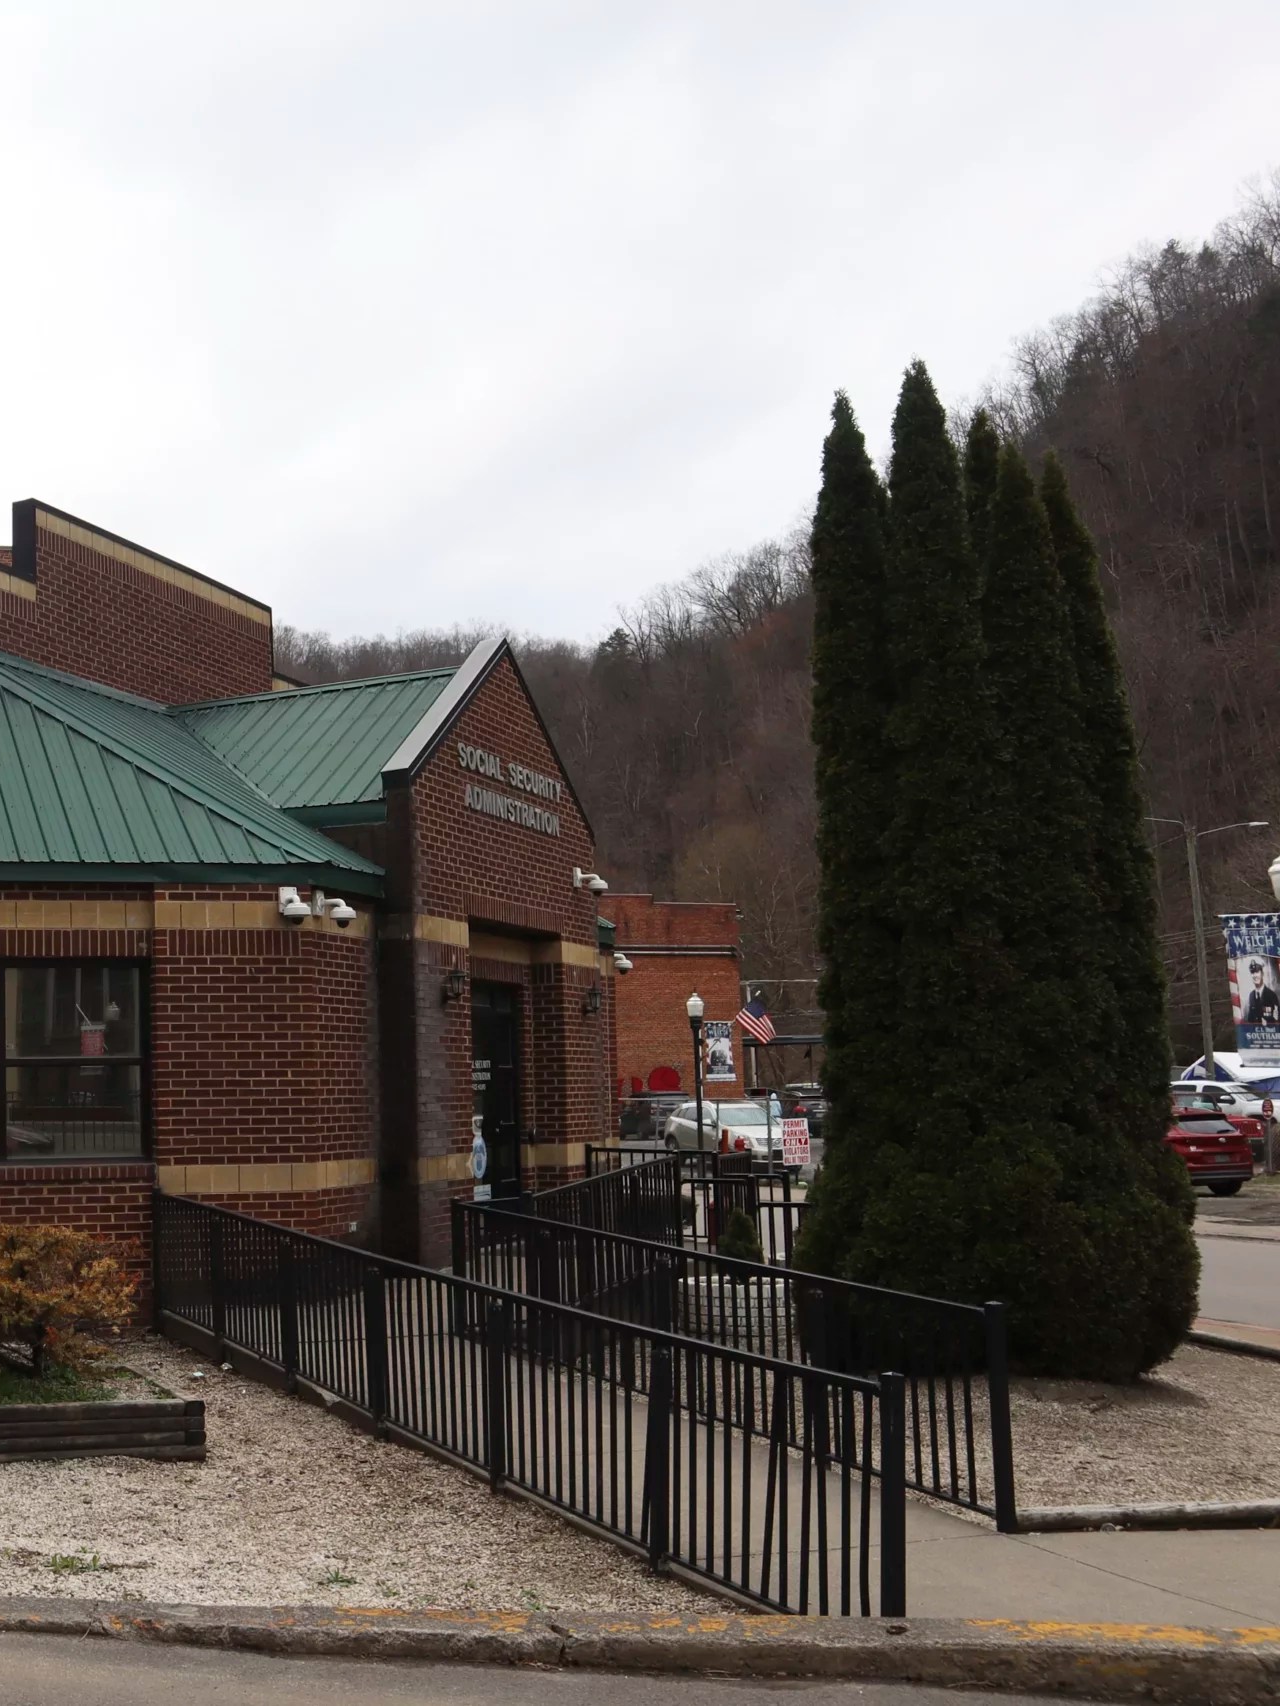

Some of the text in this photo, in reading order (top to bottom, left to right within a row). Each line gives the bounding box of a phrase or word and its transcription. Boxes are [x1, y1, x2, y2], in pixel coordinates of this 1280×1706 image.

[457, 742, 562, 803] SOCIAL SECURITY
[464, 783, 560, 837] ADMINISTRATION
[1232, 935, 1274, 947] WELCH
[783, 1120, 805, 1128] PERMIT
[782, 1129, 807, 1138] PARKING
[785, 1138, 806, 1146] ONLY
[784, 1146, 809, 1155] VIOLATORS
